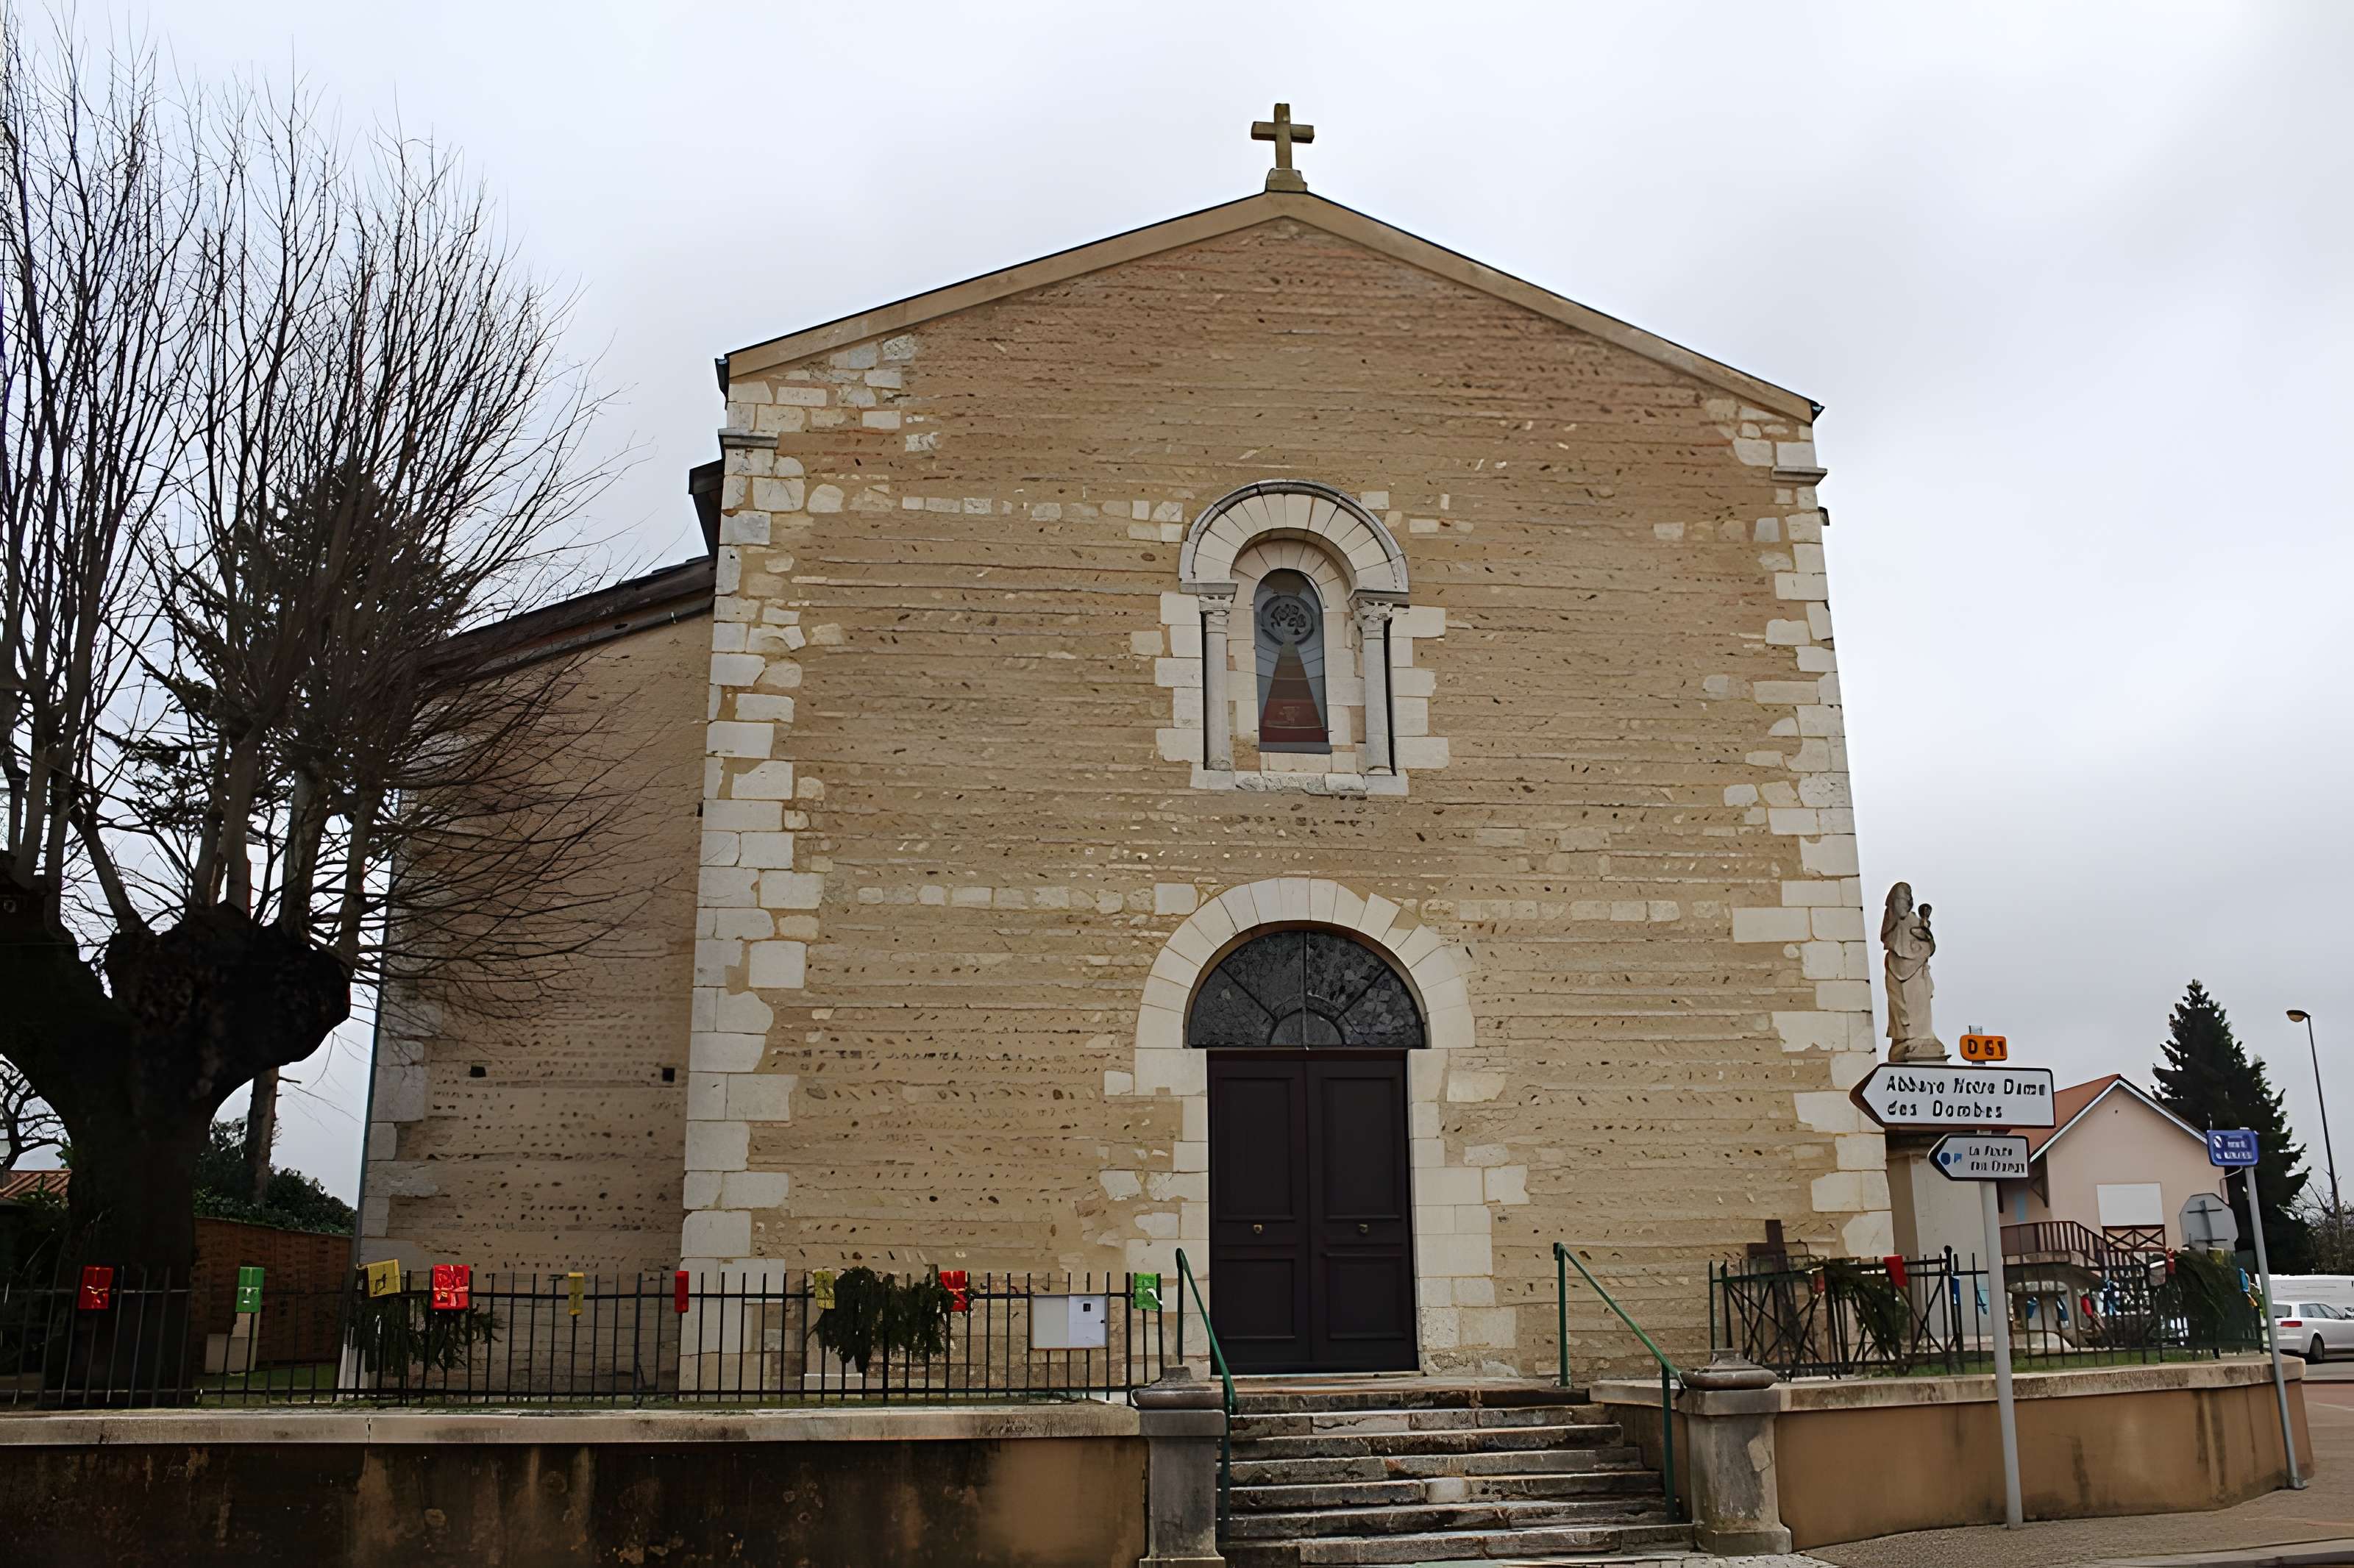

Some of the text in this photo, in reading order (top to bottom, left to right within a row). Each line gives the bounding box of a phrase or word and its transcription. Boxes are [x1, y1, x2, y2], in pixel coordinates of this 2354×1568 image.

[1967, 1038, 1978, 1055] D
[1888, 1100, 2002, 1118] des Dombes
